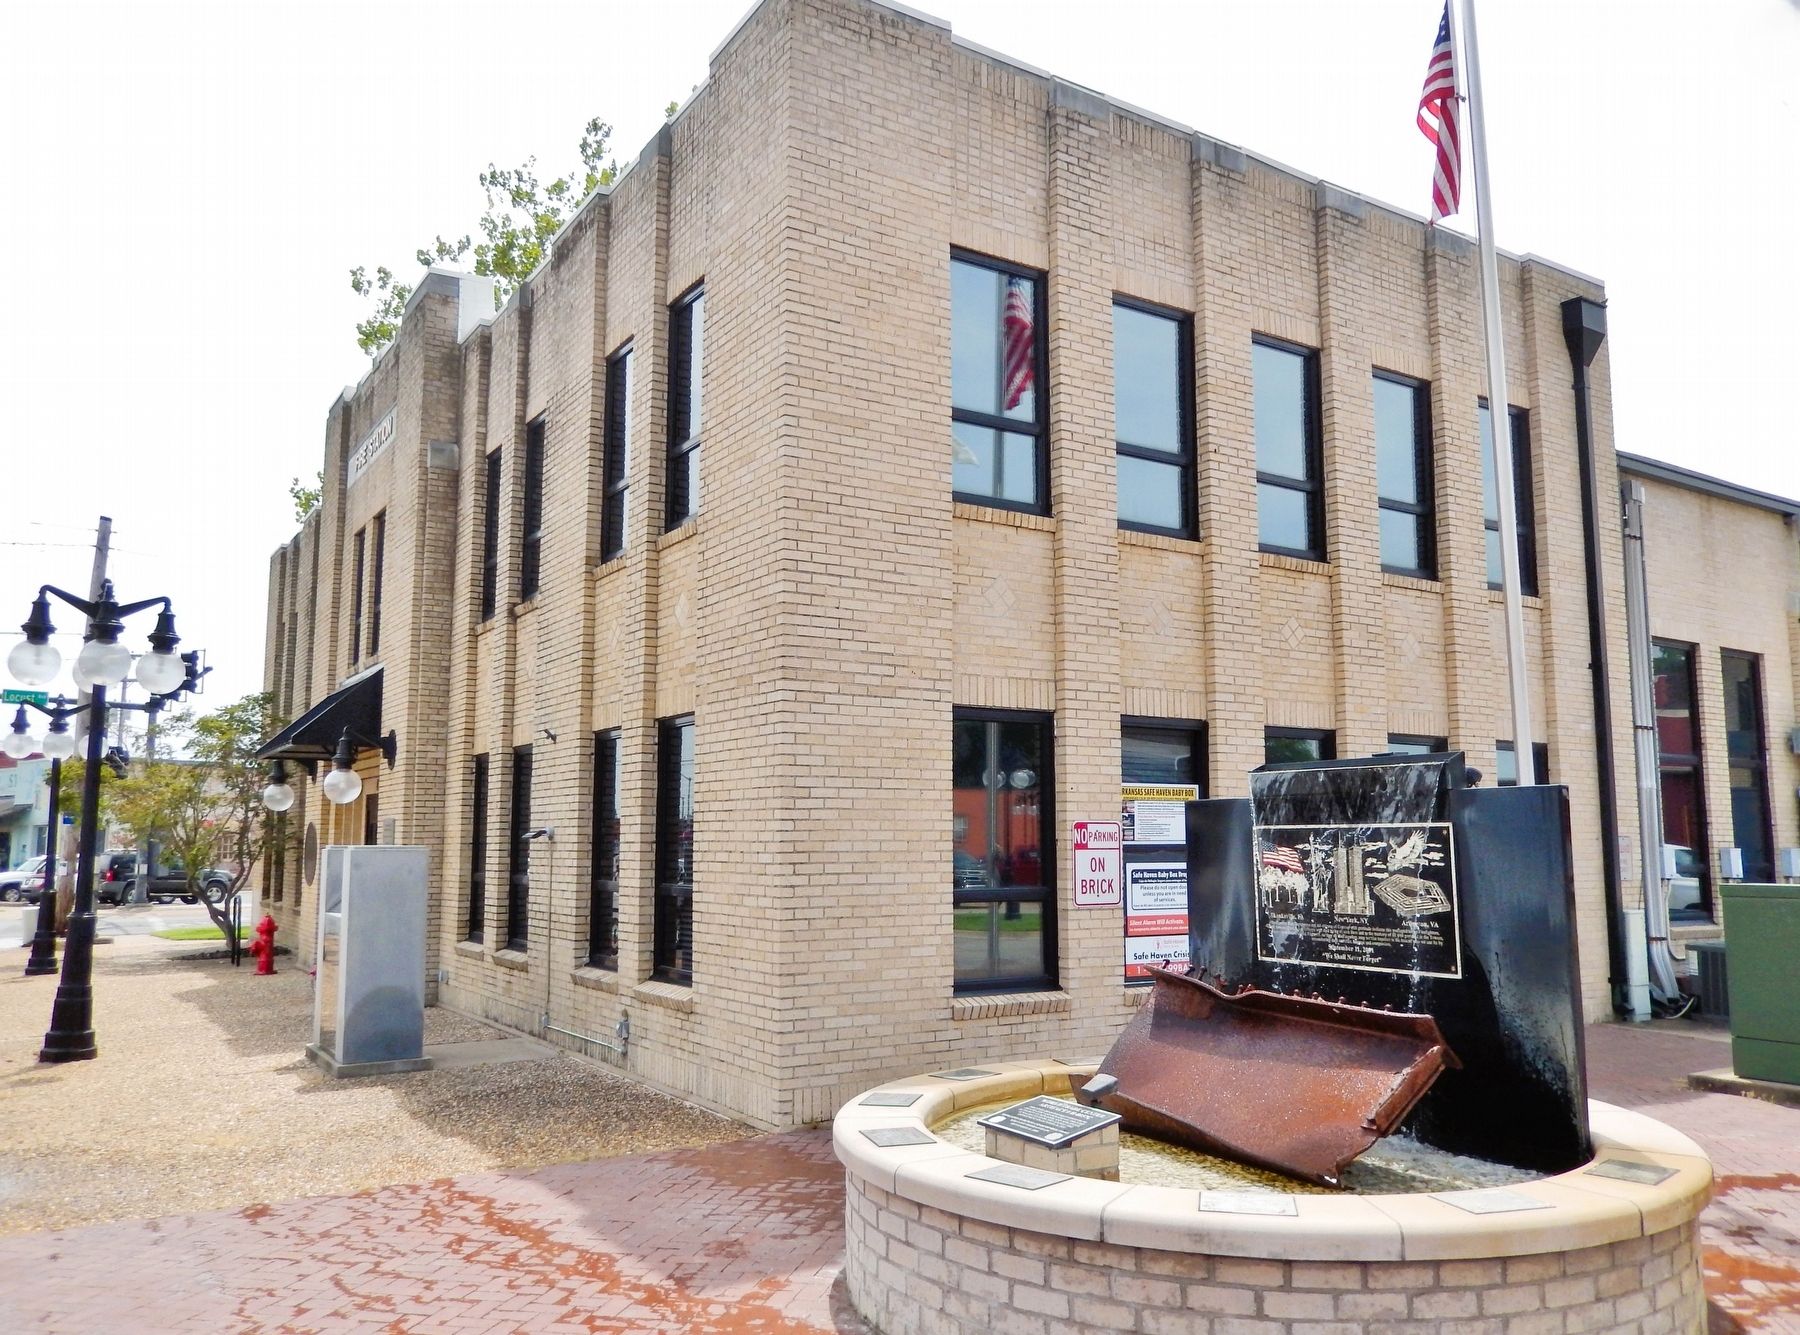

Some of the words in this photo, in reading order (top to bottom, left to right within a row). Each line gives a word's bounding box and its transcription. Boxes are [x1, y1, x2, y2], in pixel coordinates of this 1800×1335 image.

[4, 691, 35, 702] Locust
[1121, 787, 1143, 796] RKANSAS
[1144, 788, 1155, 796] SAFE
[1156, 788, 1172, 797] HAVEN
[1172, 789, 1184, 797] BABY
[1185, 789, 1194, 797] BOX
[1074, 828, 1088, 844] NO
[1089, 831, 1118, 842] PARKING
[1090, 857, 1105, 873] ON
[1158, 871, 1169, 879] Baby
[1081, 878, 1114, 895] BRICK
[1430, 920, 1439, 928] VA
[1133, 951, 1149, 960] Safe
[1150, 951, 1172, 959] Haven
